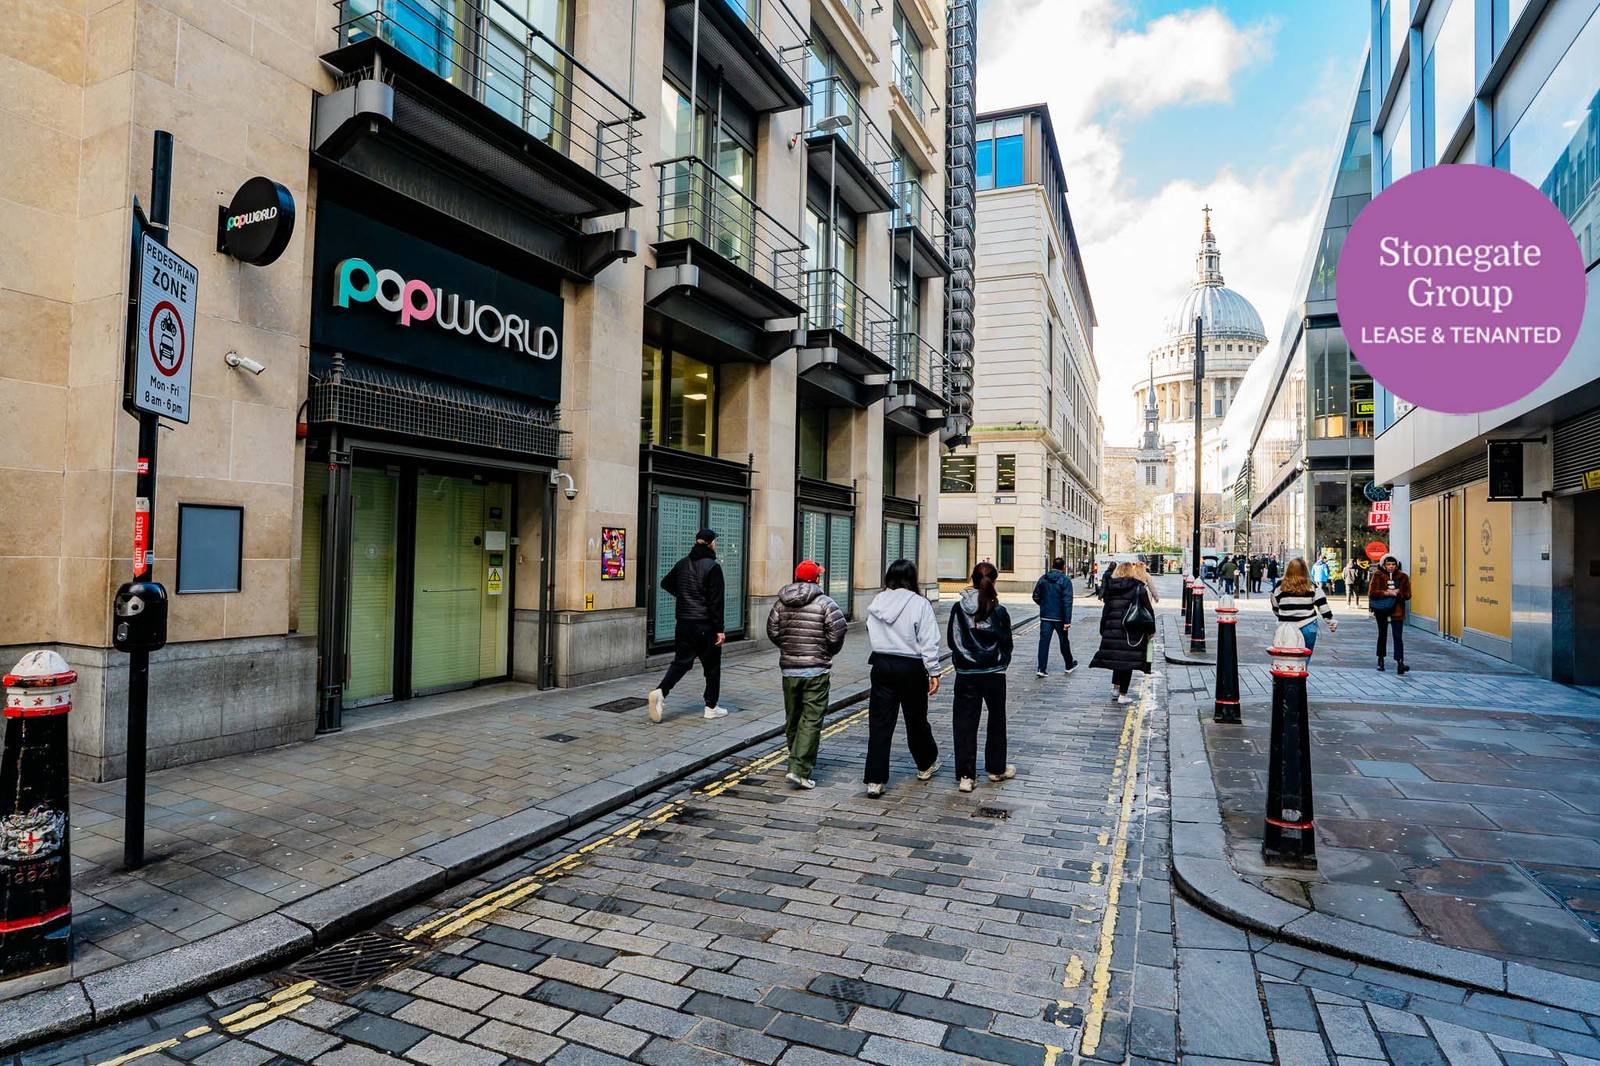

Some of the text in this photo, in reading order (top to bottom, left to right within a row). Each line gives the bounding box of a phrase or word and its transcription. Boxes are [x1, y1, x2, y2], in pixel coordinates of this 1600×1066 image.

[146, 242, 196, 285] PEDESTRIAN
[152, 265, 187, 303] ZONE
[150, 375, 166, 391] Mon
[170, 384, 179, 397] Fri
[135, 516, 144, 541] butts
[134, 547, 144, 569] gum
